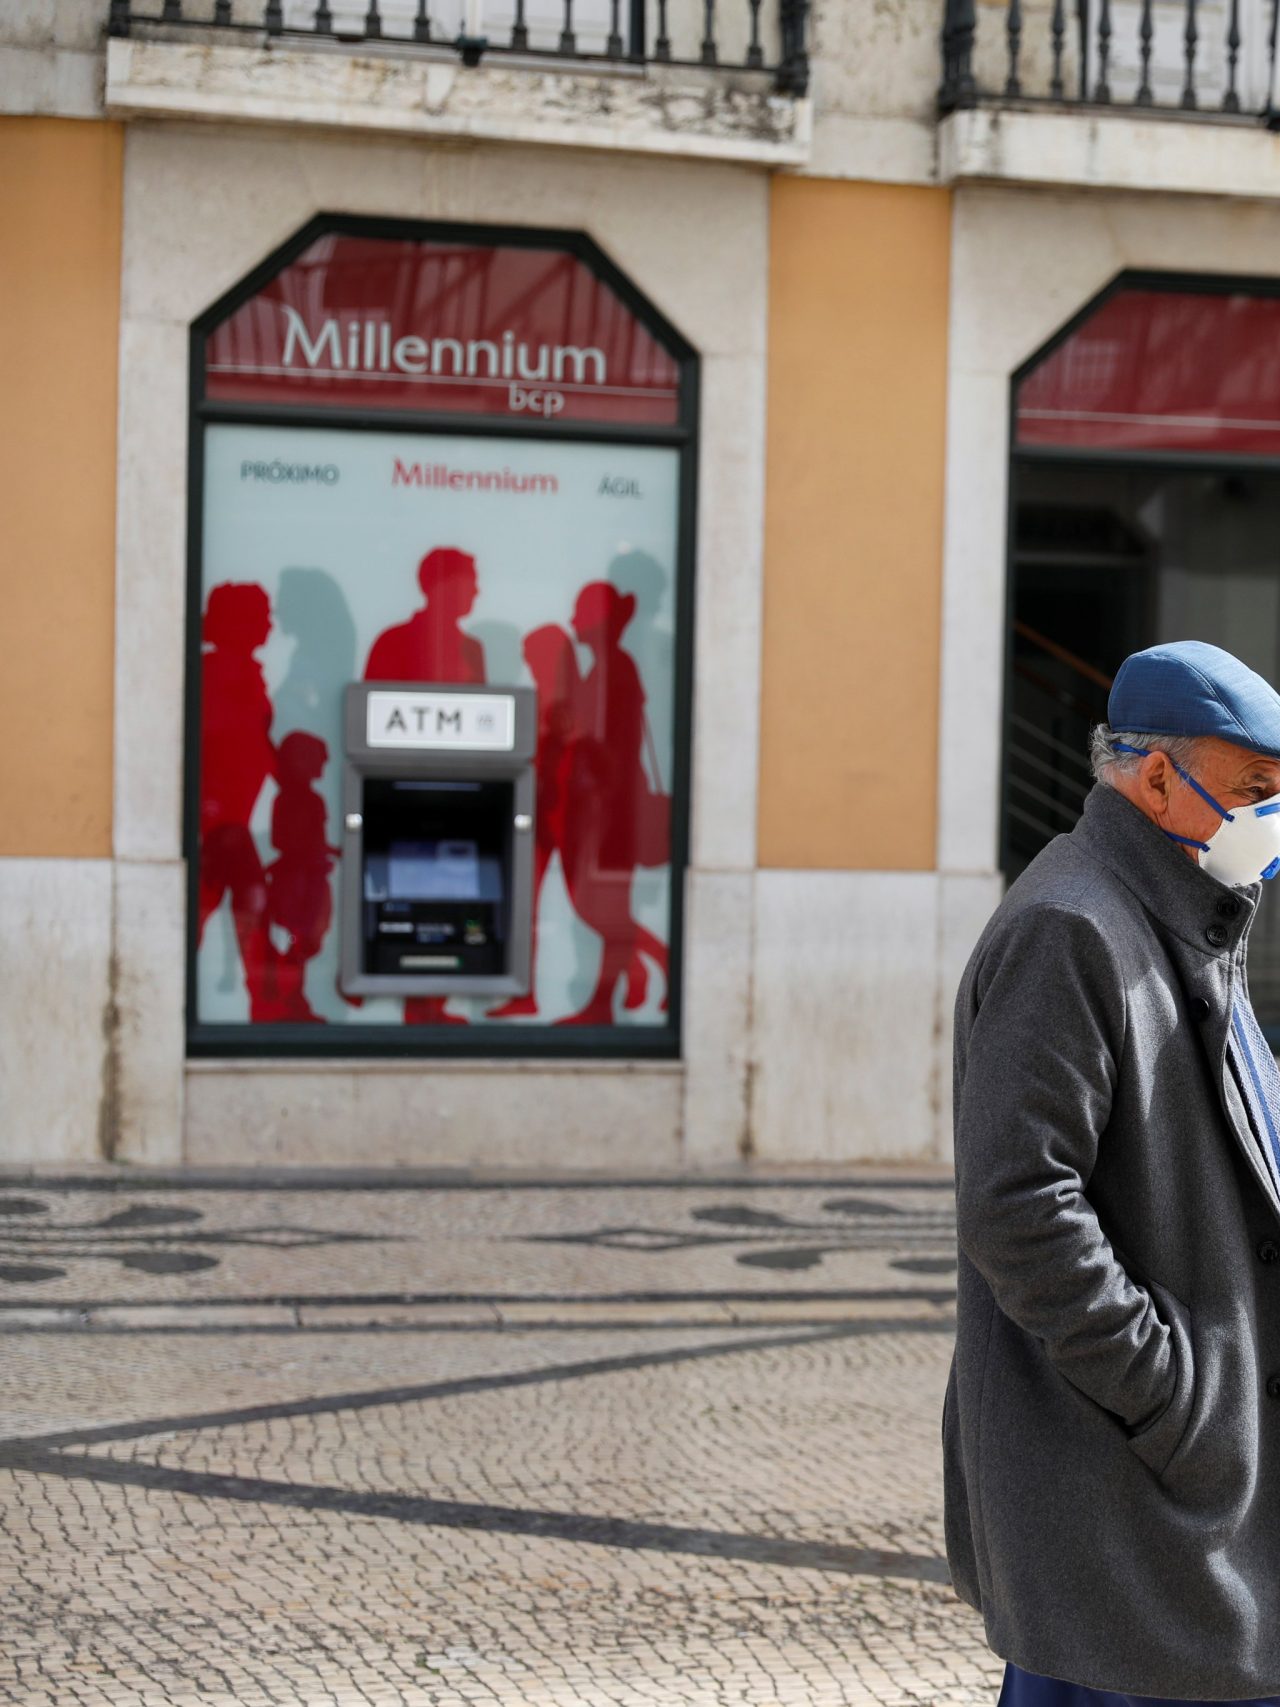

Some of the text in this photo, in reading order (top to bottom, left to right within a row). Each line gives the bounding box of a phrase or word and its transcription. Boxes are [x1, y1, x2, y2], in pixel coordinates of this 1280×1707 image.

[280, 305, 606, 385] Millennium
[508, 383, 565, 417] bcp
[240, 459, 340, 486] PRÓXIMO
[391, 456, 559, 495] Millennium
[598, 473, 642, 499] ÁGIL
[385, 705, 463, 733] ATM
